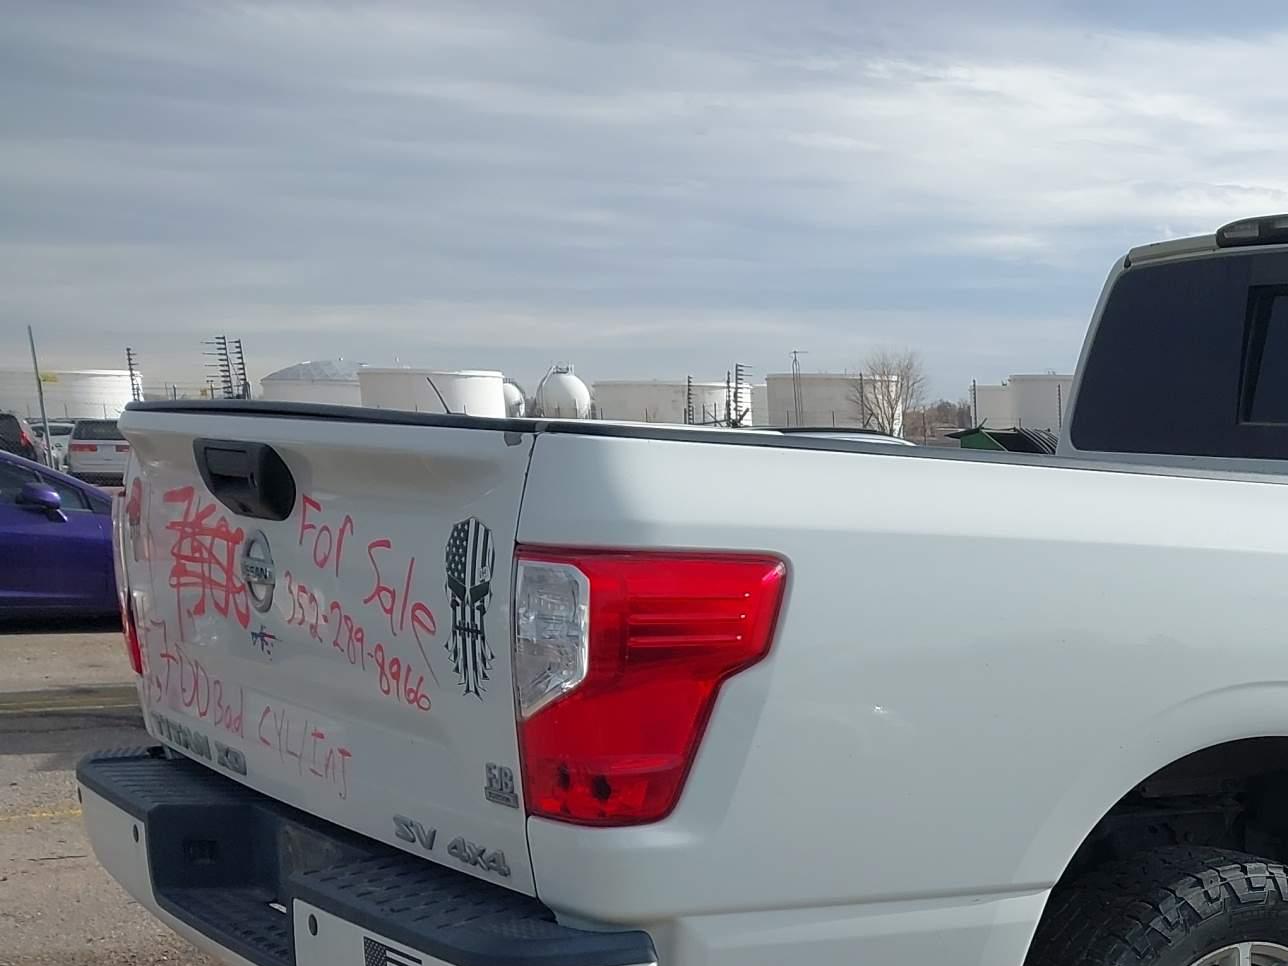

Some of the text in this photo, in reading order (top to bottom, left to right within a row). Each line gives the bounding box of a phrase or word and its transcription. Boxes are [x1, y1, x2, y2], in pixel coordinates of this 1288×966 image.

[300, 493, 441, 688] For Sale
[213, 678, 245, 739] Bad
[214, 740, 247, 777] XD
[393, 814, 437, 851] SV
